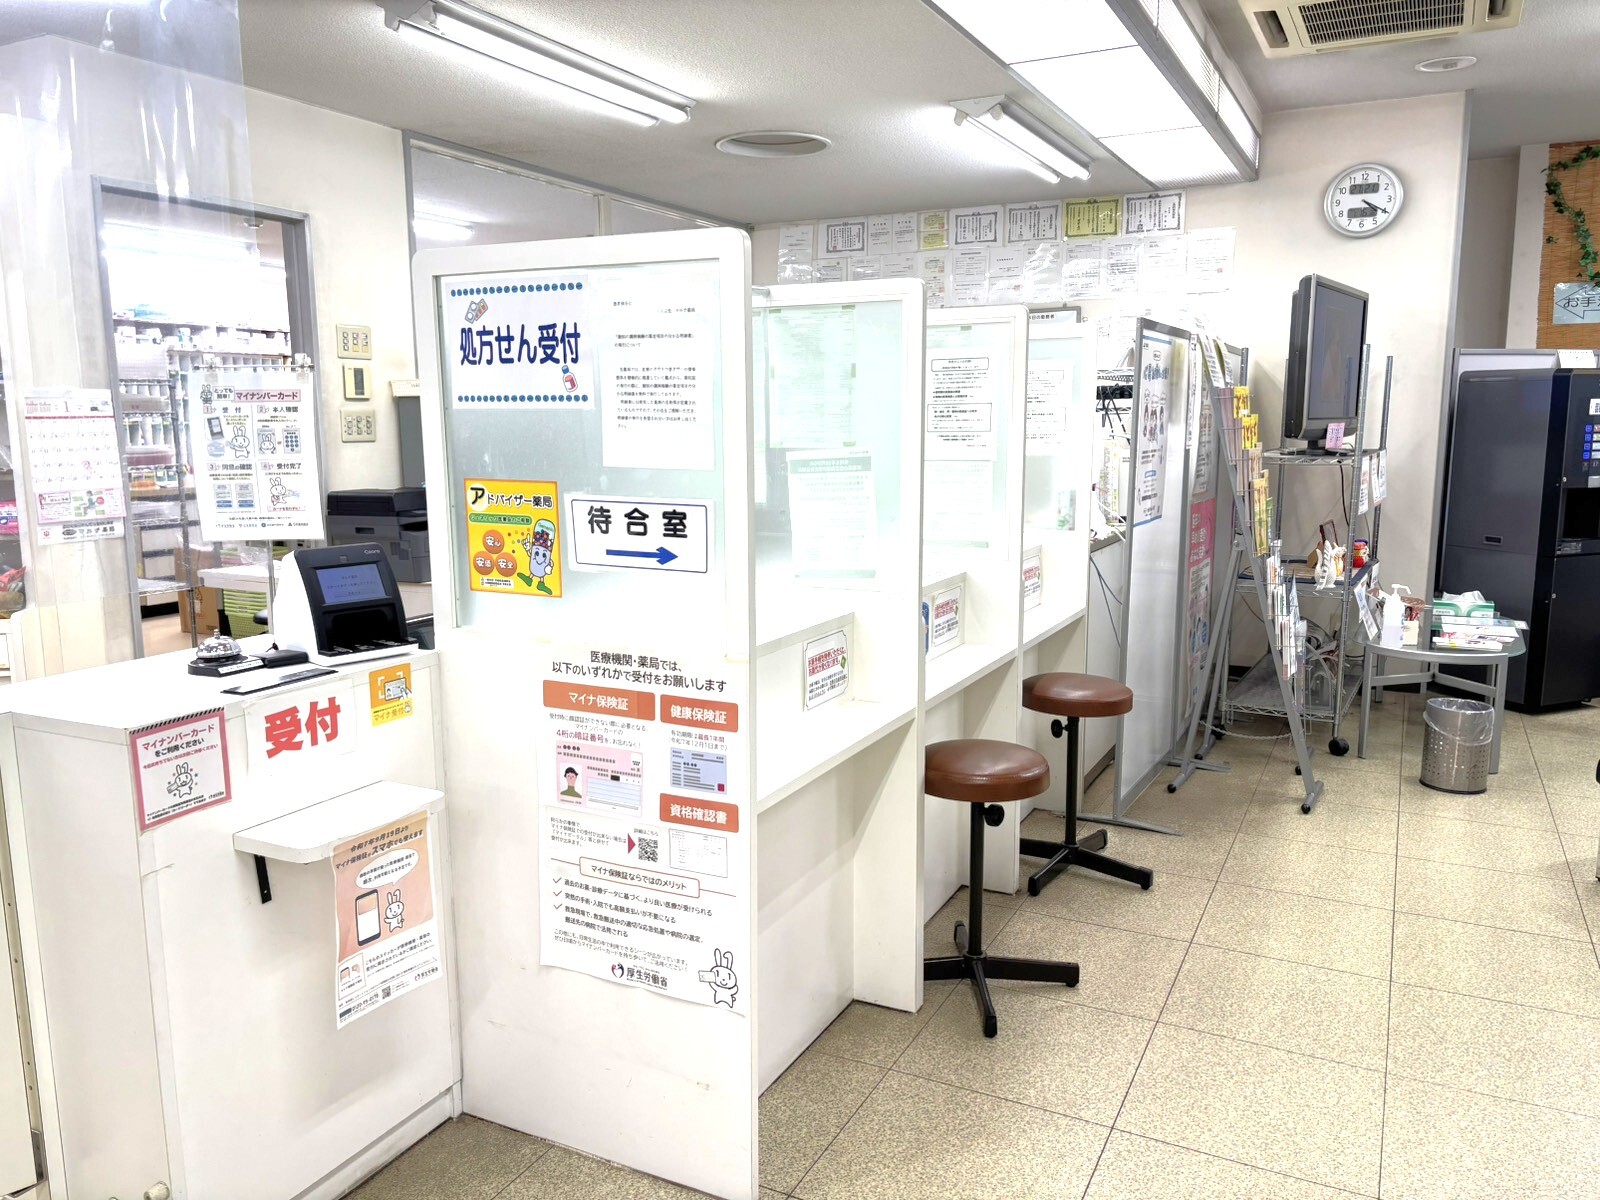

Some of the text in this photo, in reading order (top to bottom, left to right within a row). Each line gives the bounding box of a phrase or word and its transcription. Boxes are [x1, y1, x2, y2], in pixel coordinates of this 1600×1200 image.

[1373, 217, 1377, 225] 5
[1564, 296, 1600, 308] お手
[460, 322, 581, 366] 処方せん受付
[236, 392, 298, 401] マイナンバーカード
[276, 462, 302, 470] 受付完了
[470, 486, 554, 508] アドバイザー薬局
[588, 506, 688, 538] 待合室
[485, 536, 502, 548] 安心
[498, 557, 514, 570] 安全
[590, 650, 682, 673] 医療機関・薬局では、
[552, 661, 727, 693] 以下のいずれかで受付をお願いします
[568, 692, 629, 711] マイナ保険証
[373, 707, 404, 722] マイナ受付
[670, 704, 727, 724] 健康保険証
[142, 723, 216, 752] マイナンバーカード
[264, 696, 342, 759] 受付
[154, 736, 205, 758] をご利用ください
[670, 804, 728, 824] 資格確認書
[350, 825, 409, 853] 令和7年9月19日より
[591, 864, 687, 891] マイナ保険証ならではのメリット
[564, 916, 629, 938] 搬送先の病院で活用される
[626, 967, 668, 988] 厚生労働省
